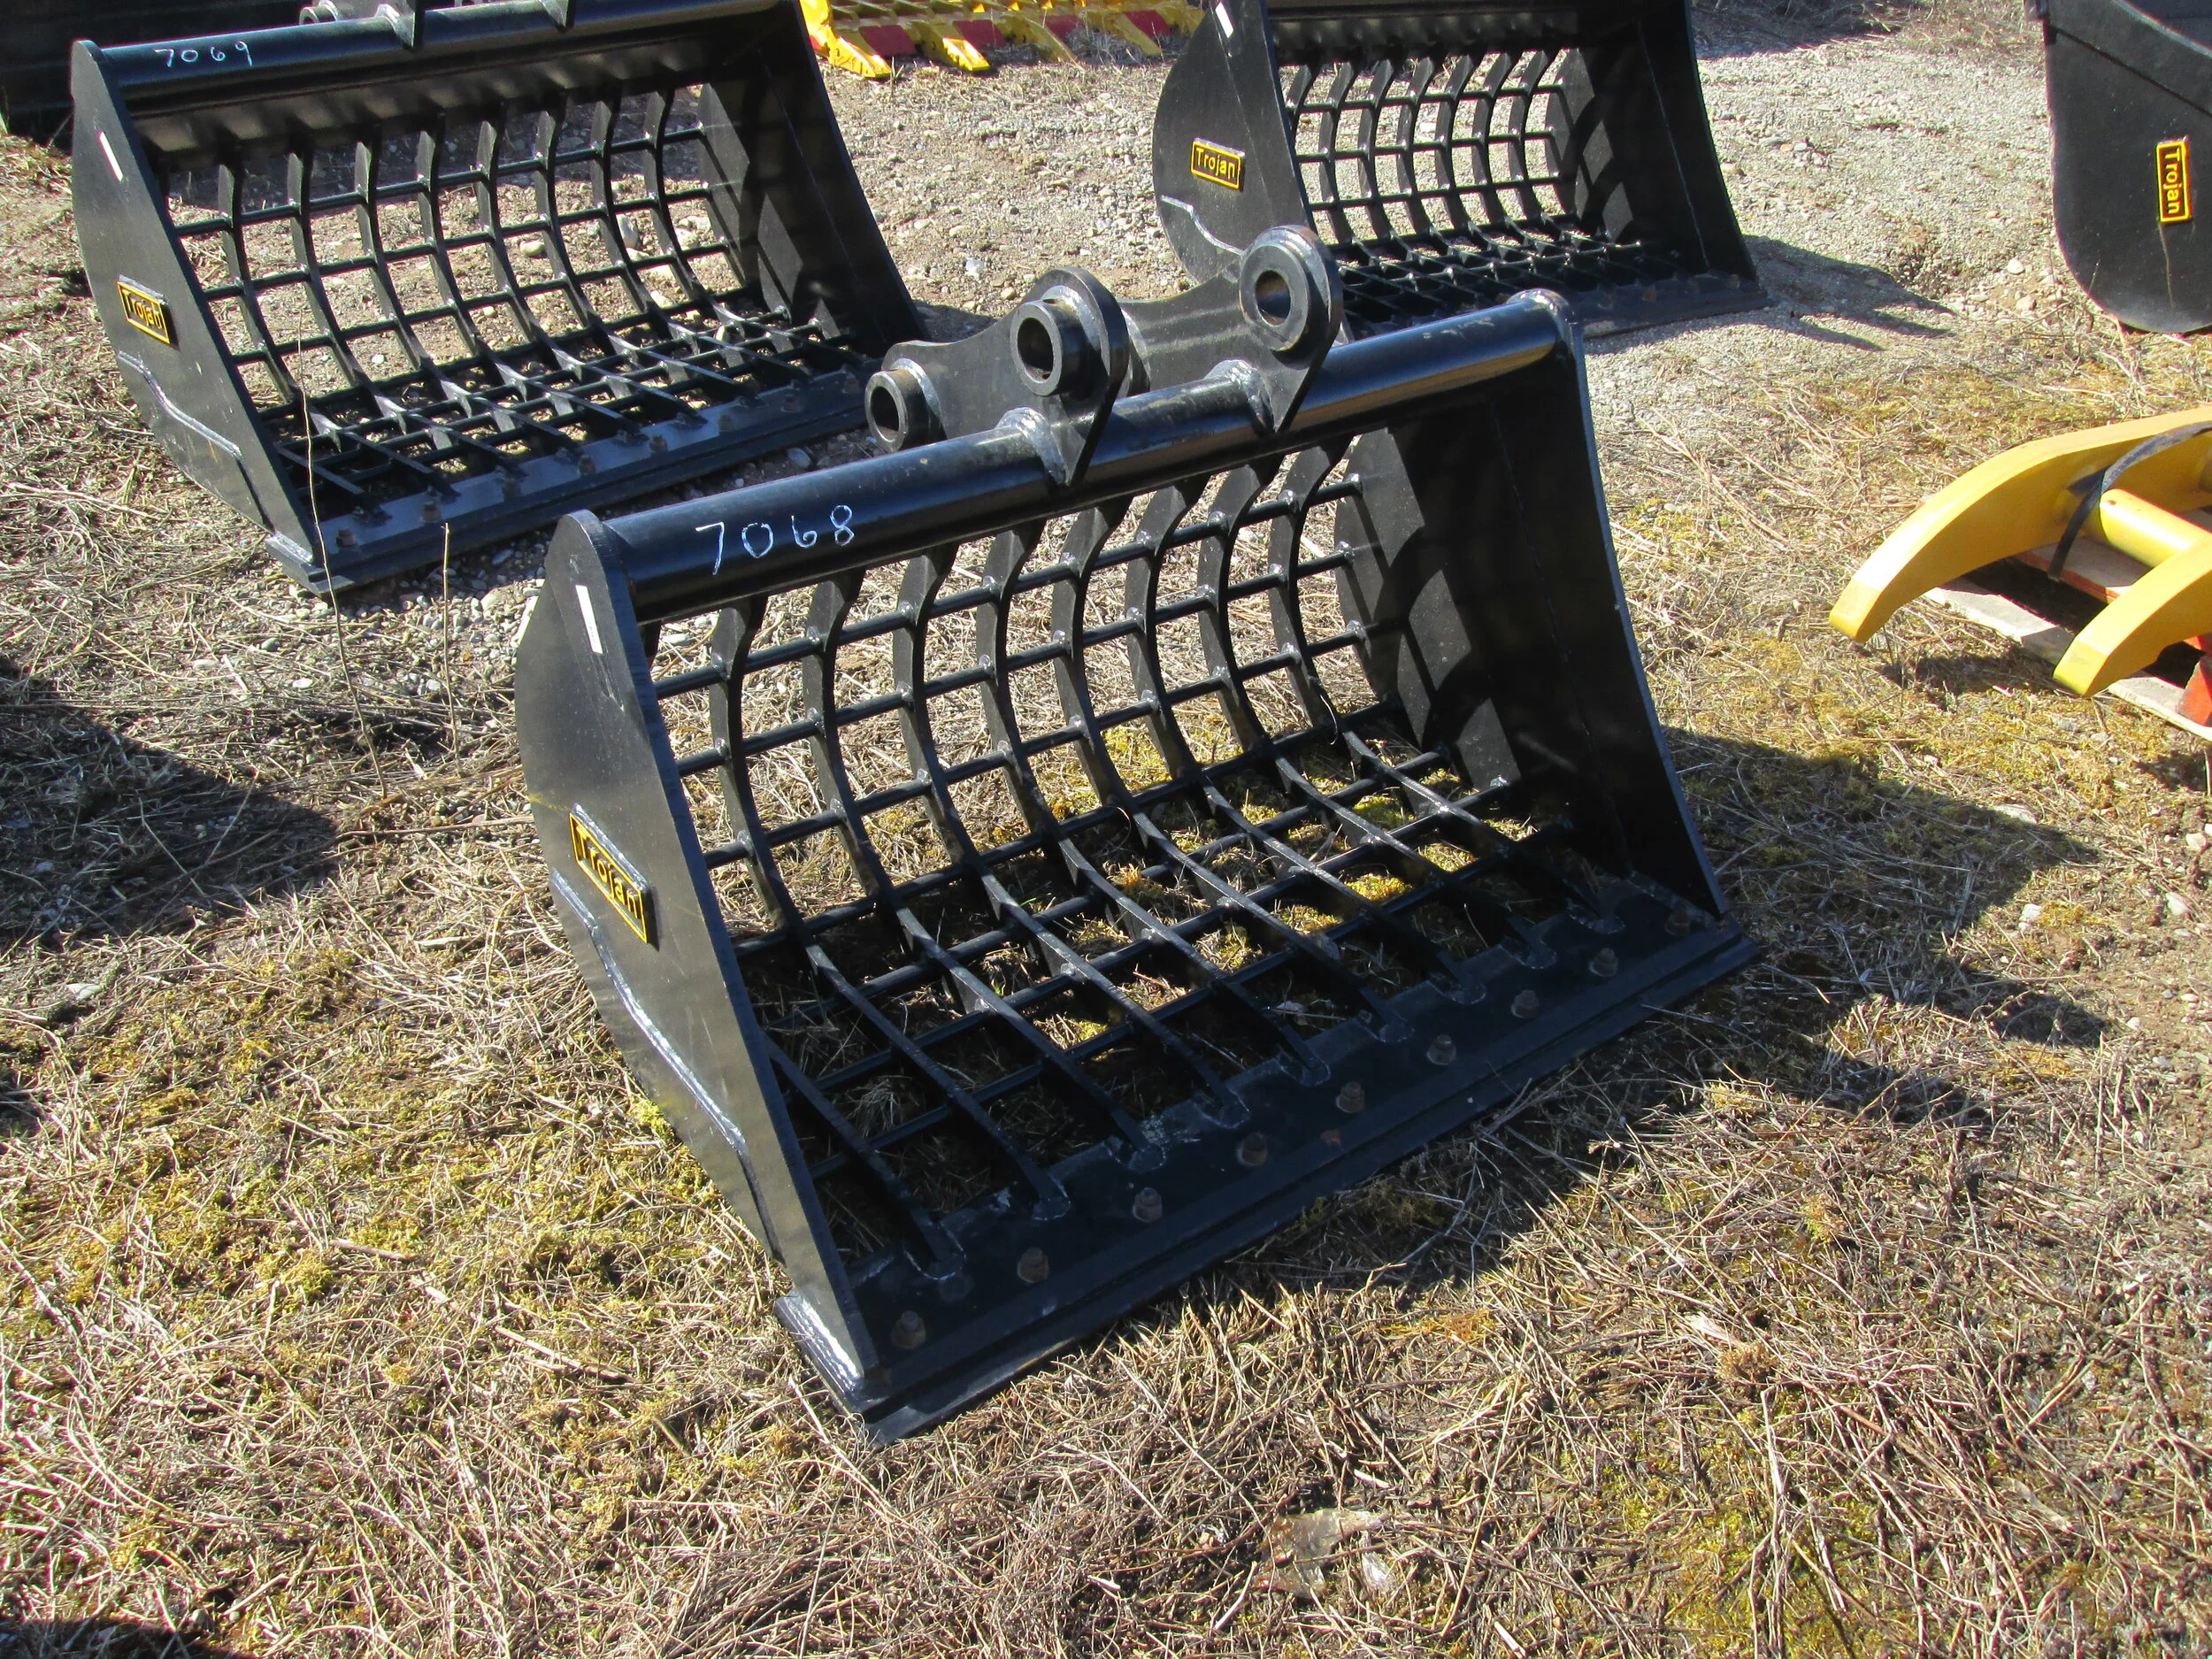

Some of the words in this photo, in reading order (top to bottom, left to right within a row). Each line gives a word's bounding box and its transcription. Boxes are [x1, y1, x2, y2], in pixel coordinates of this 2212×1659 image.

[154, 41, 253, 68] 7069
[1195, 147, 1236, 180] Trojan
[2163, 148, 2182, 214] Trojan
[121, 288, 163, 330] Trojan
[695, 504, 855, 575] 7068
[576, 826, 638, 918] Trojan
